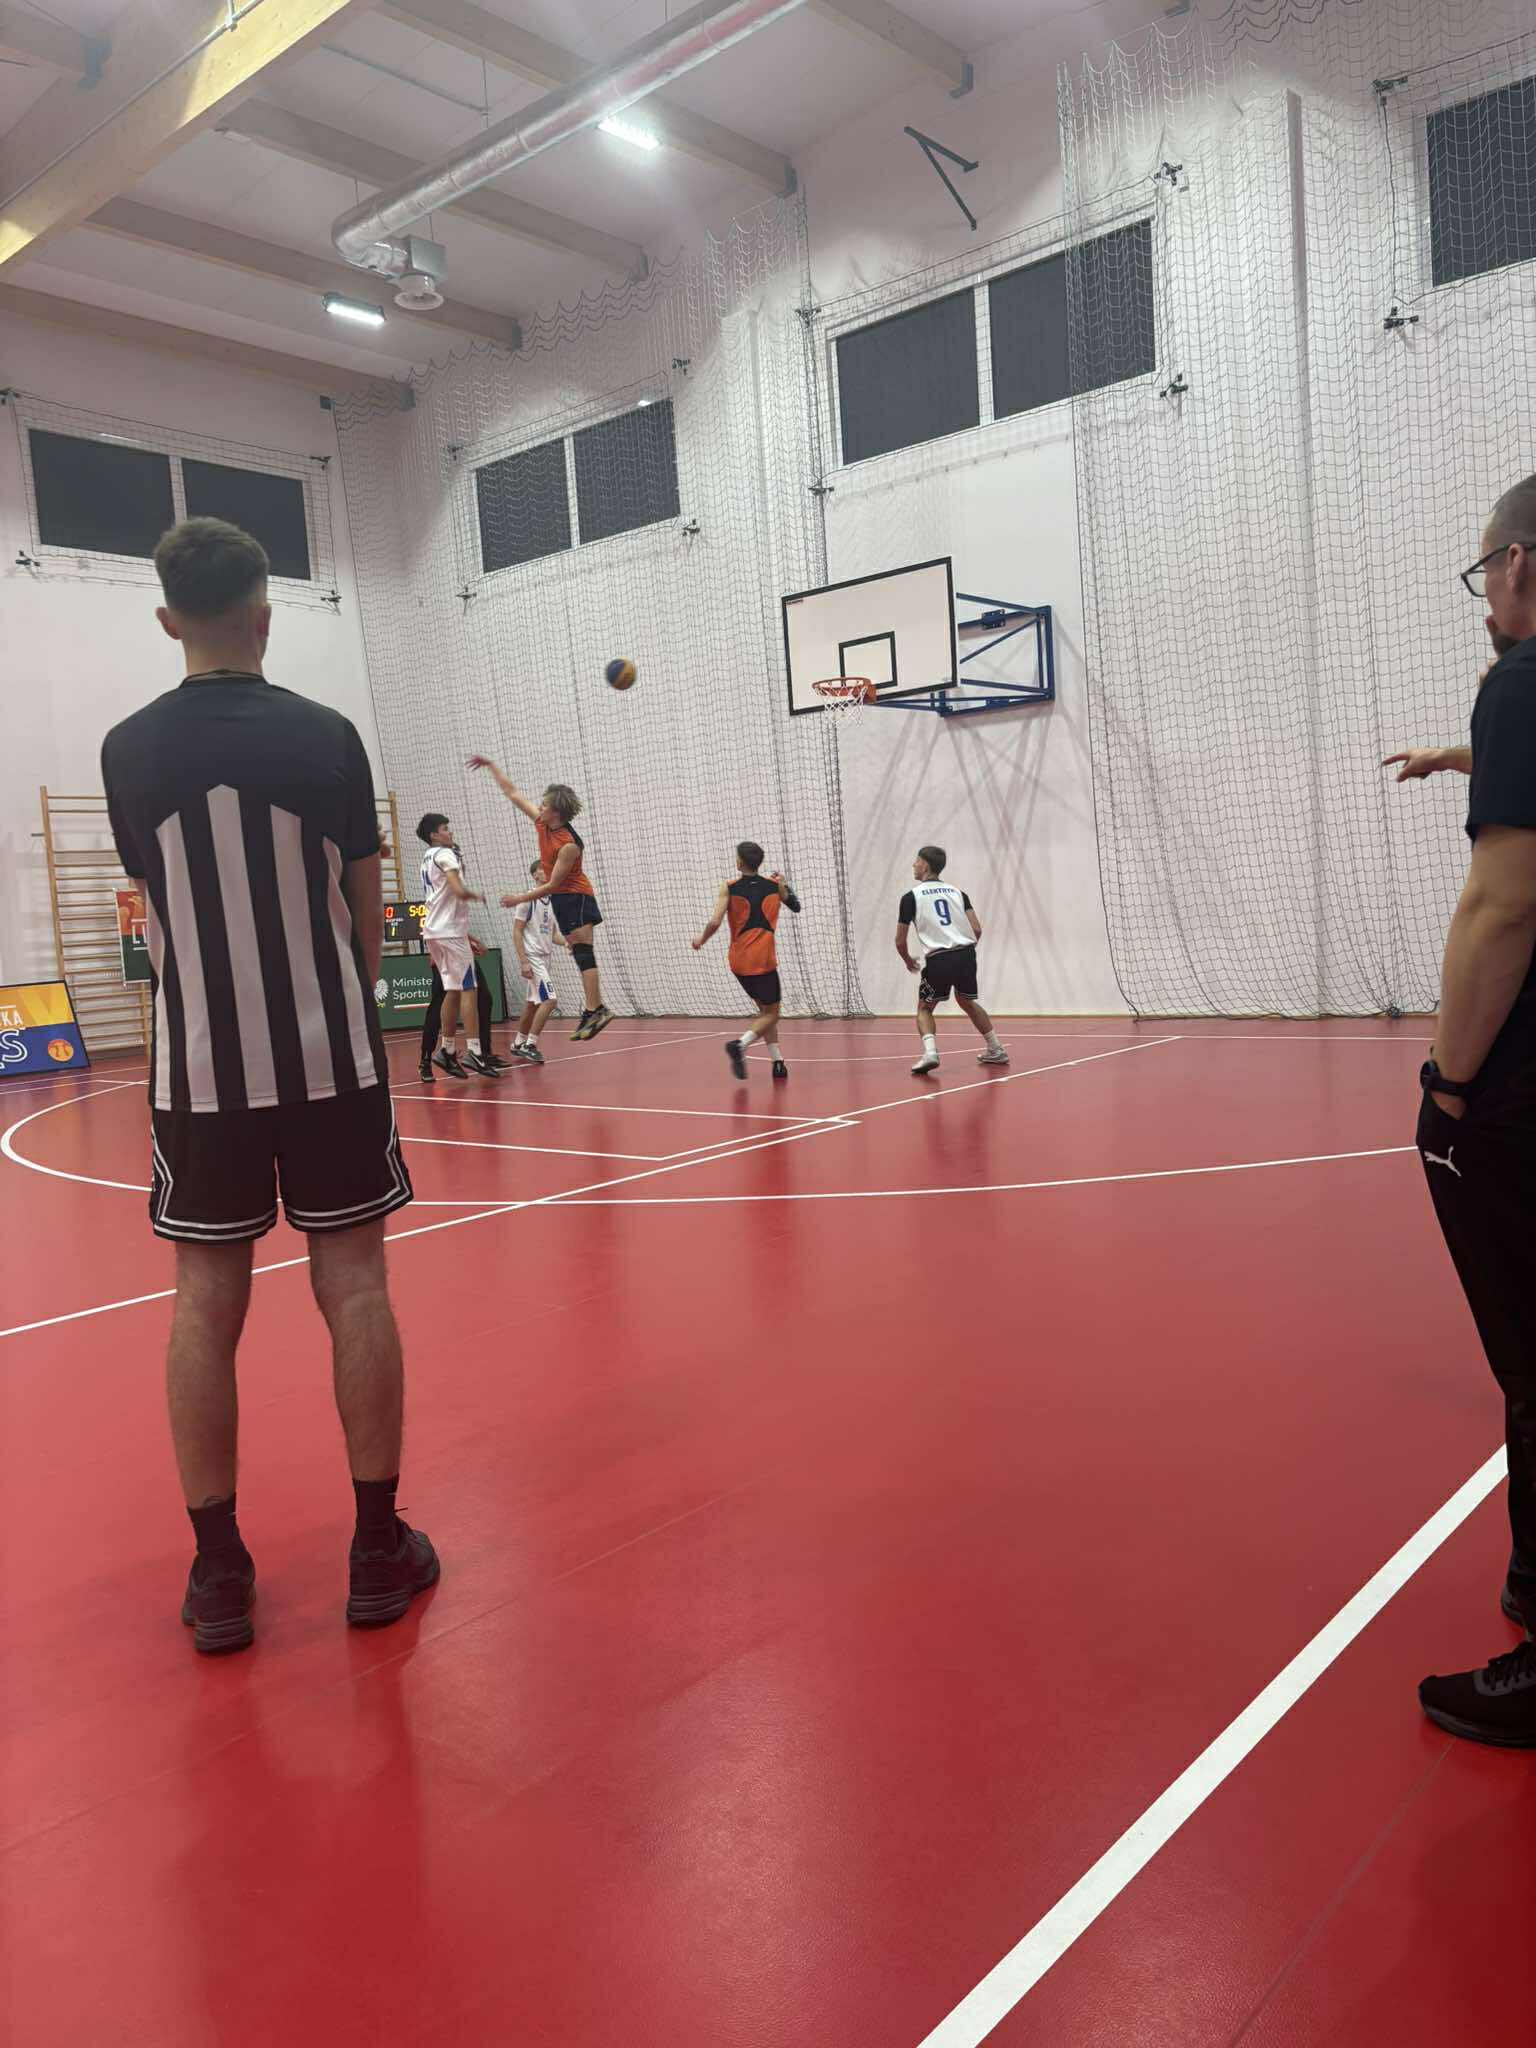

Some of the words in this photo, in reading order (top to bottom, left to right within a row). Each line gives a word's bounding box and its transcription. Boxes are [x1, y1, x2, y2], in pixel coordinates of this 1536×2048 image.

[934, 898, 952, 926] 9
[393, 989, 429, 1001] Sportu
[0, 1010, 24, 1027] KA
